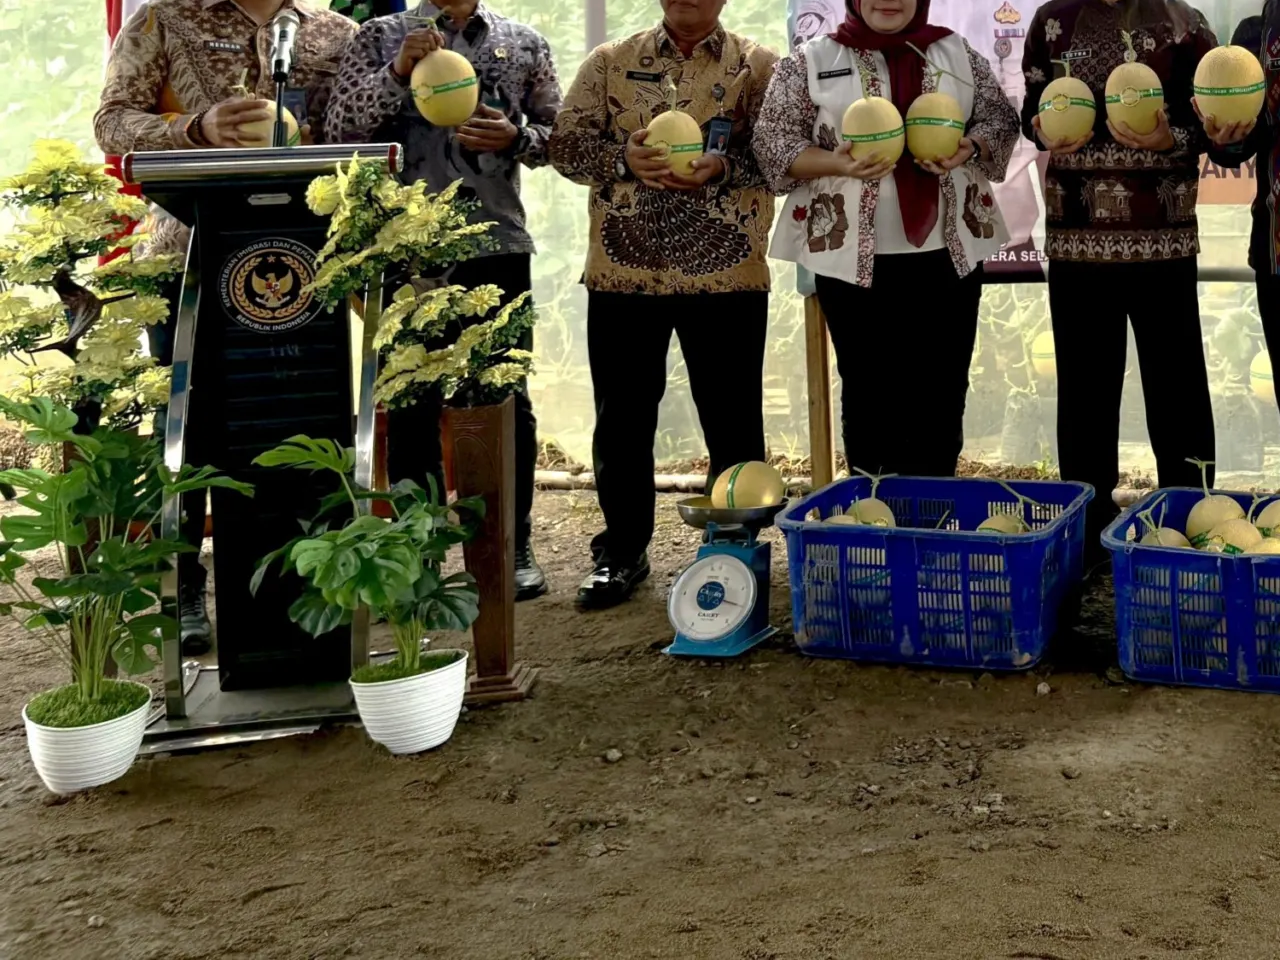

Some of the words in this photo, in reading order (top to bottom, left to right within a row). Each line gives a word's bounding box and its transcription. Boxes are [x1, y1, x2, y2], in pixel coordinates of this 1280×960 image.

[985, 251, 1018, 262] ERA
[220, 258, 239, 308] KEMENTERIAN
[237, 241, 271, 259] IMIGRASI
[273, 241, 291, 249] DAN
[291, 245, 315, 264] PEMAS
[236, 314, 271, 331] REPUBLIK
[272, 311, 311, 331] INDONESIA
